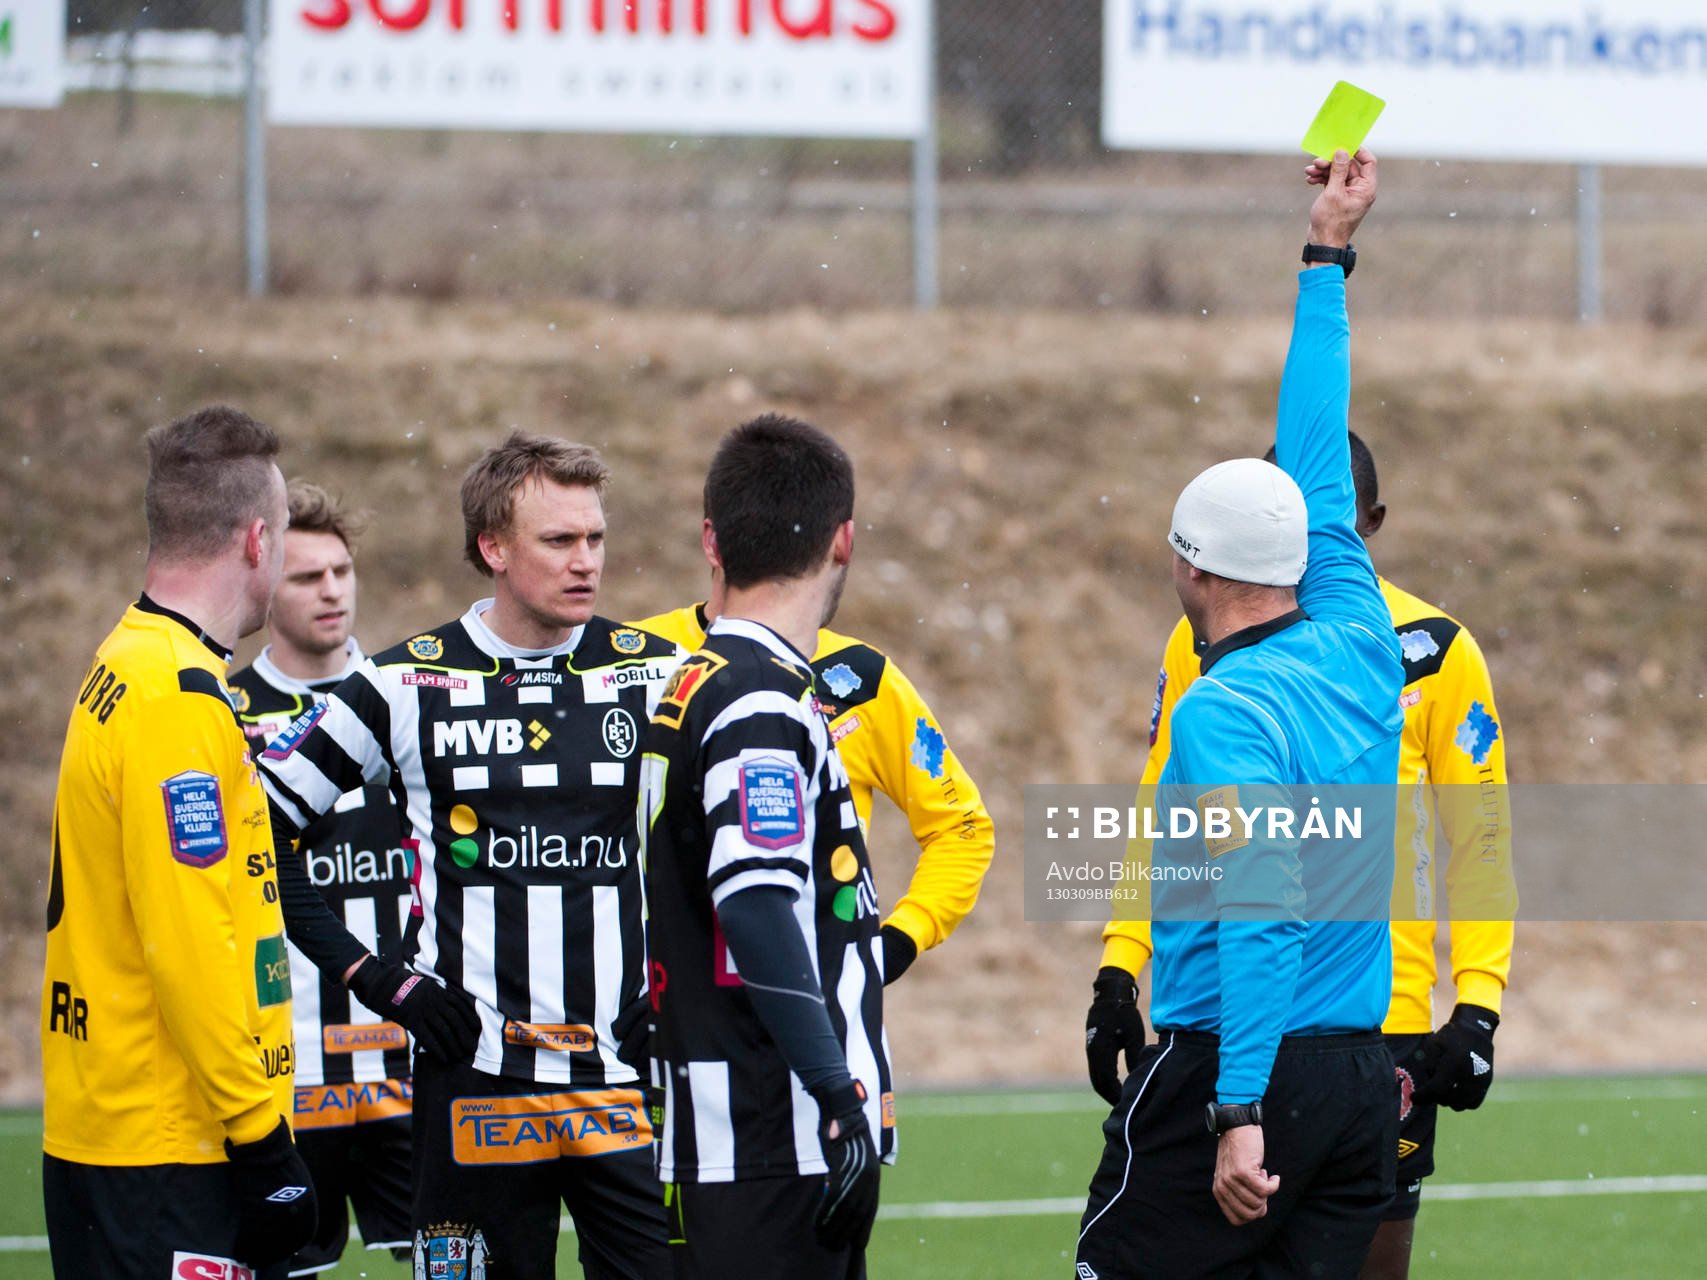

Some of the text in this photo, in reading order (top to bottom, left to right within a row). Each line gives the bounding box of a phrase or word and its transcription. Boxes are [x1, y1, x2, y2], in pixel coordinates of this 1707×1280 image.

[1130, 0, 1707, 70] Handelsbanken
[403, 674, 466, 689] TEAM SPORTIA
[520, 671, 563, 685] MASITA
[602, 667, 666, 688] MOBILL
[79, 663, 127, 726] ORG
[433, 718, 524, 757] MVB
[758, 776, 785, 787] HELA
[183, 790, 207, 802] HELA
[174, 801, 217, 814] SVERIGES
[174, 811, 220, 824] FOTBOLLS
[487, 824, 627, 868] bila.nu
[508, 1025, 590, 1045] TEAMAB
[293, 1082, 413, 1115] EAMA
[458, 1102, 638, 1147] TEAMAB
